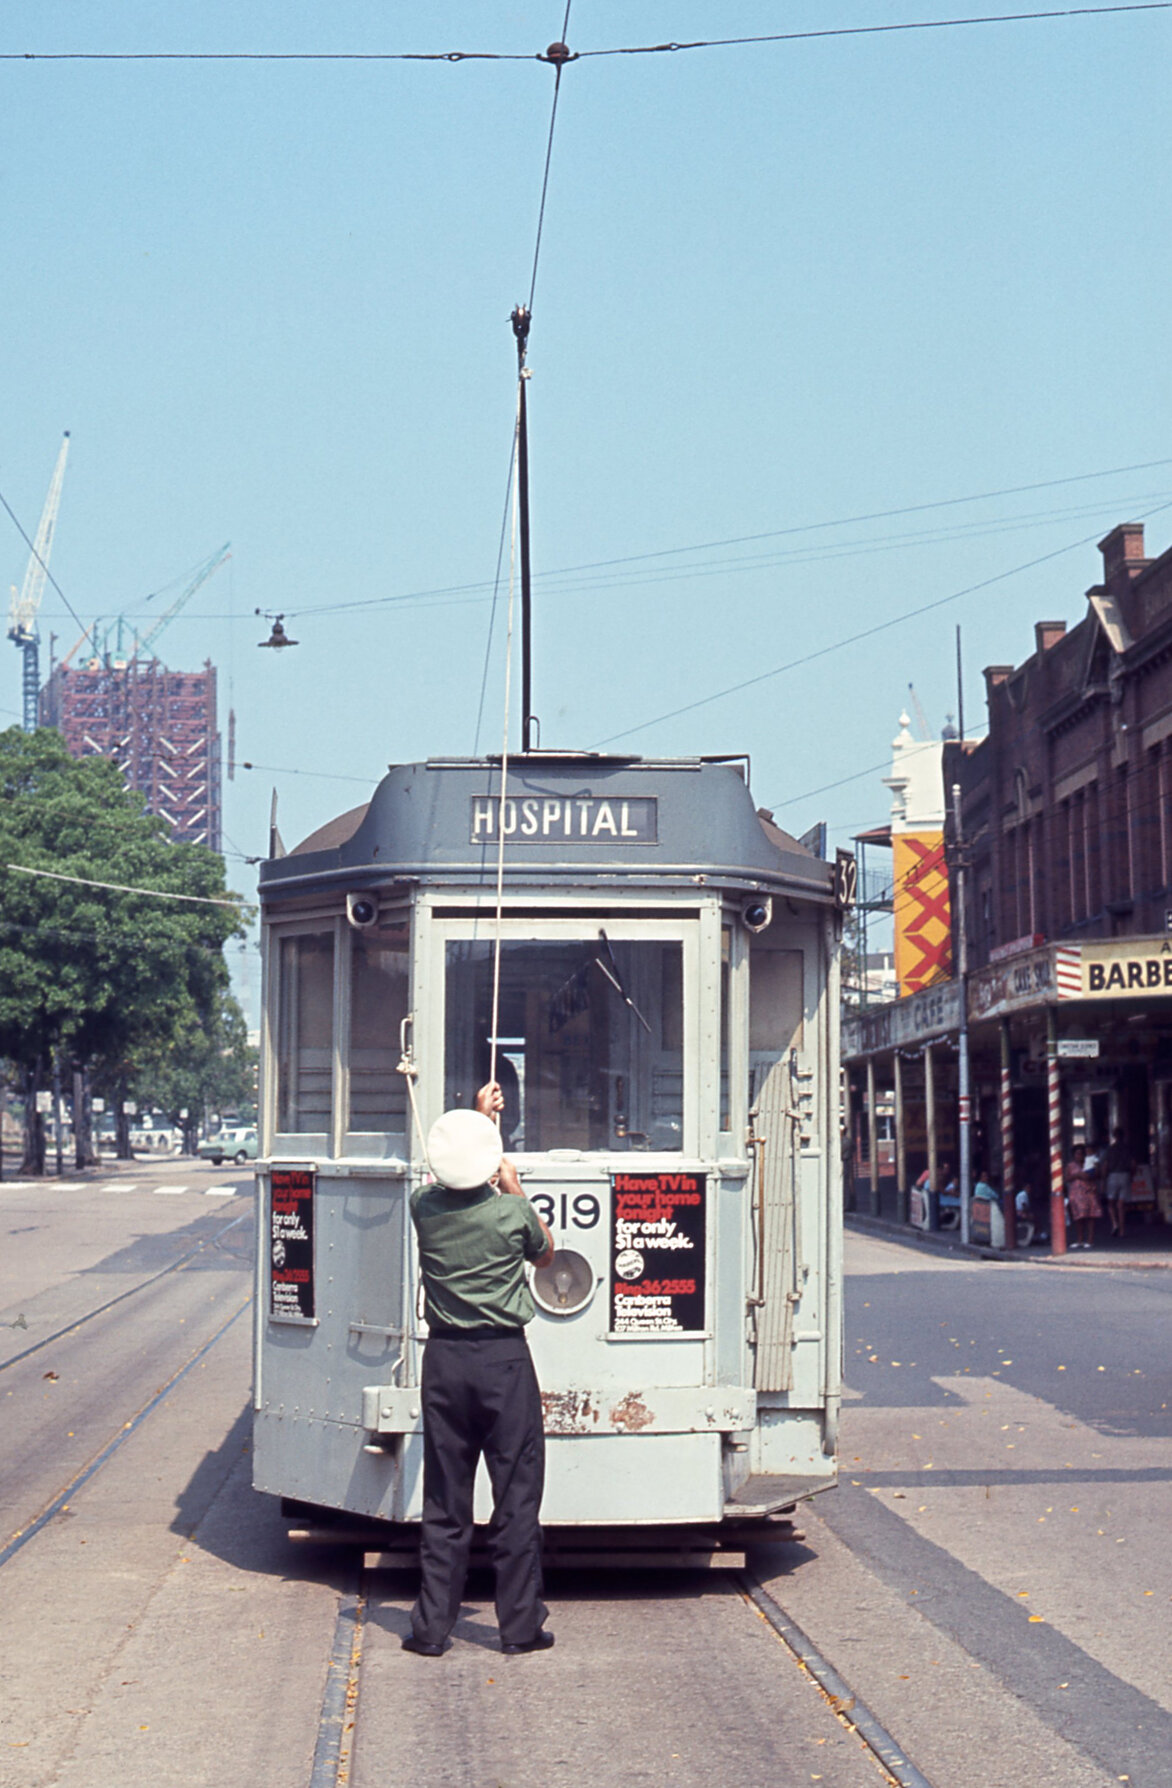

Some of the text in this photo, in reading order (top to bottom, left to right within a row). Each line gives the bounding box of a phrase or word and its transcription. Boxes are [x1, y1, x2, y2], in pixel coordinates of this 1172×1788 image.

[474, 799, 638, 837] HOSPITAL
[839, 859, 857, 905] 32
[615, 1174, 697, 1191] Have TV in
[616, 1189, 701, 1209] your home
[283, 1211, 300, 1228] only
[616, 1205, 674, 1223] tonight
[615, 1217, 677, 1238] for only
[633, 1237, 644, 1249] a
[644, 1232, 694, 1251] week.
[614, 1278, 696, 1296] Ring 36 2555
[614, 1294, 672, 1306] Canberra
[614, 1305, 672, 1317] Television
